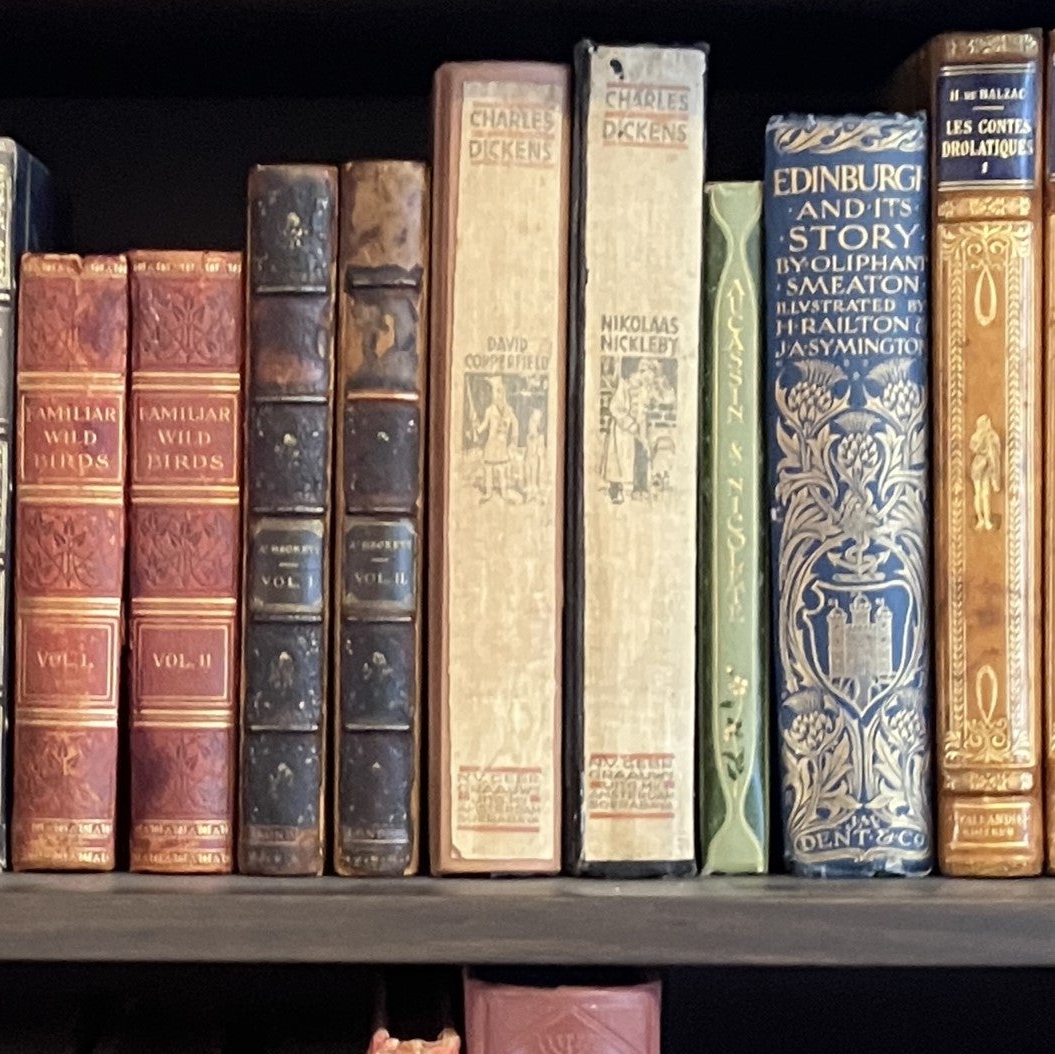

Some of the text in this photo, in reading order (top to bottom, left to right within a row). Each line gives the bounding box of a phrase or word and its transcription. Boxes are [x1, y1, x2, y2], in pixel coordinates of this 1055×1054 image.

[605, 90, 689, 111] CHARLES
[469, 110, 555, 130] CHARLES
[946, 119, 1031, 135] LES CONTES
[602, 120, 687, 141] DICKENS
[468, 140, 552, 161] DICKENS
[942, 139, 1033, 159] DROLATIQUES
[797, 197, 913, 220] AND ITS
[789, 224, 919, 252] STORY
[776, 256, 806, 274] BY
[786, 275, 919, 296] SMEATON
[601, 315, 679, 333] NIKOLAAS
[801, 316, 909, 334] RAILTON
[487, 336, 528, 352] DAVID
[601, 335, 679, 356] NICKLEBY
[726, 279, 745, 424] AUCASSIN
[26, 405, 116, 424] FAMILIAR
[139, 405, 231, 424] FAMILIAR
[44, 429, 97, 446] WILD
[157, 429, 211, 446] WILD
[34, 451, 109, 470] BIRDS
[147, 453, 224, 470] BIRDS
[802, 822, 871, 851] DENT
